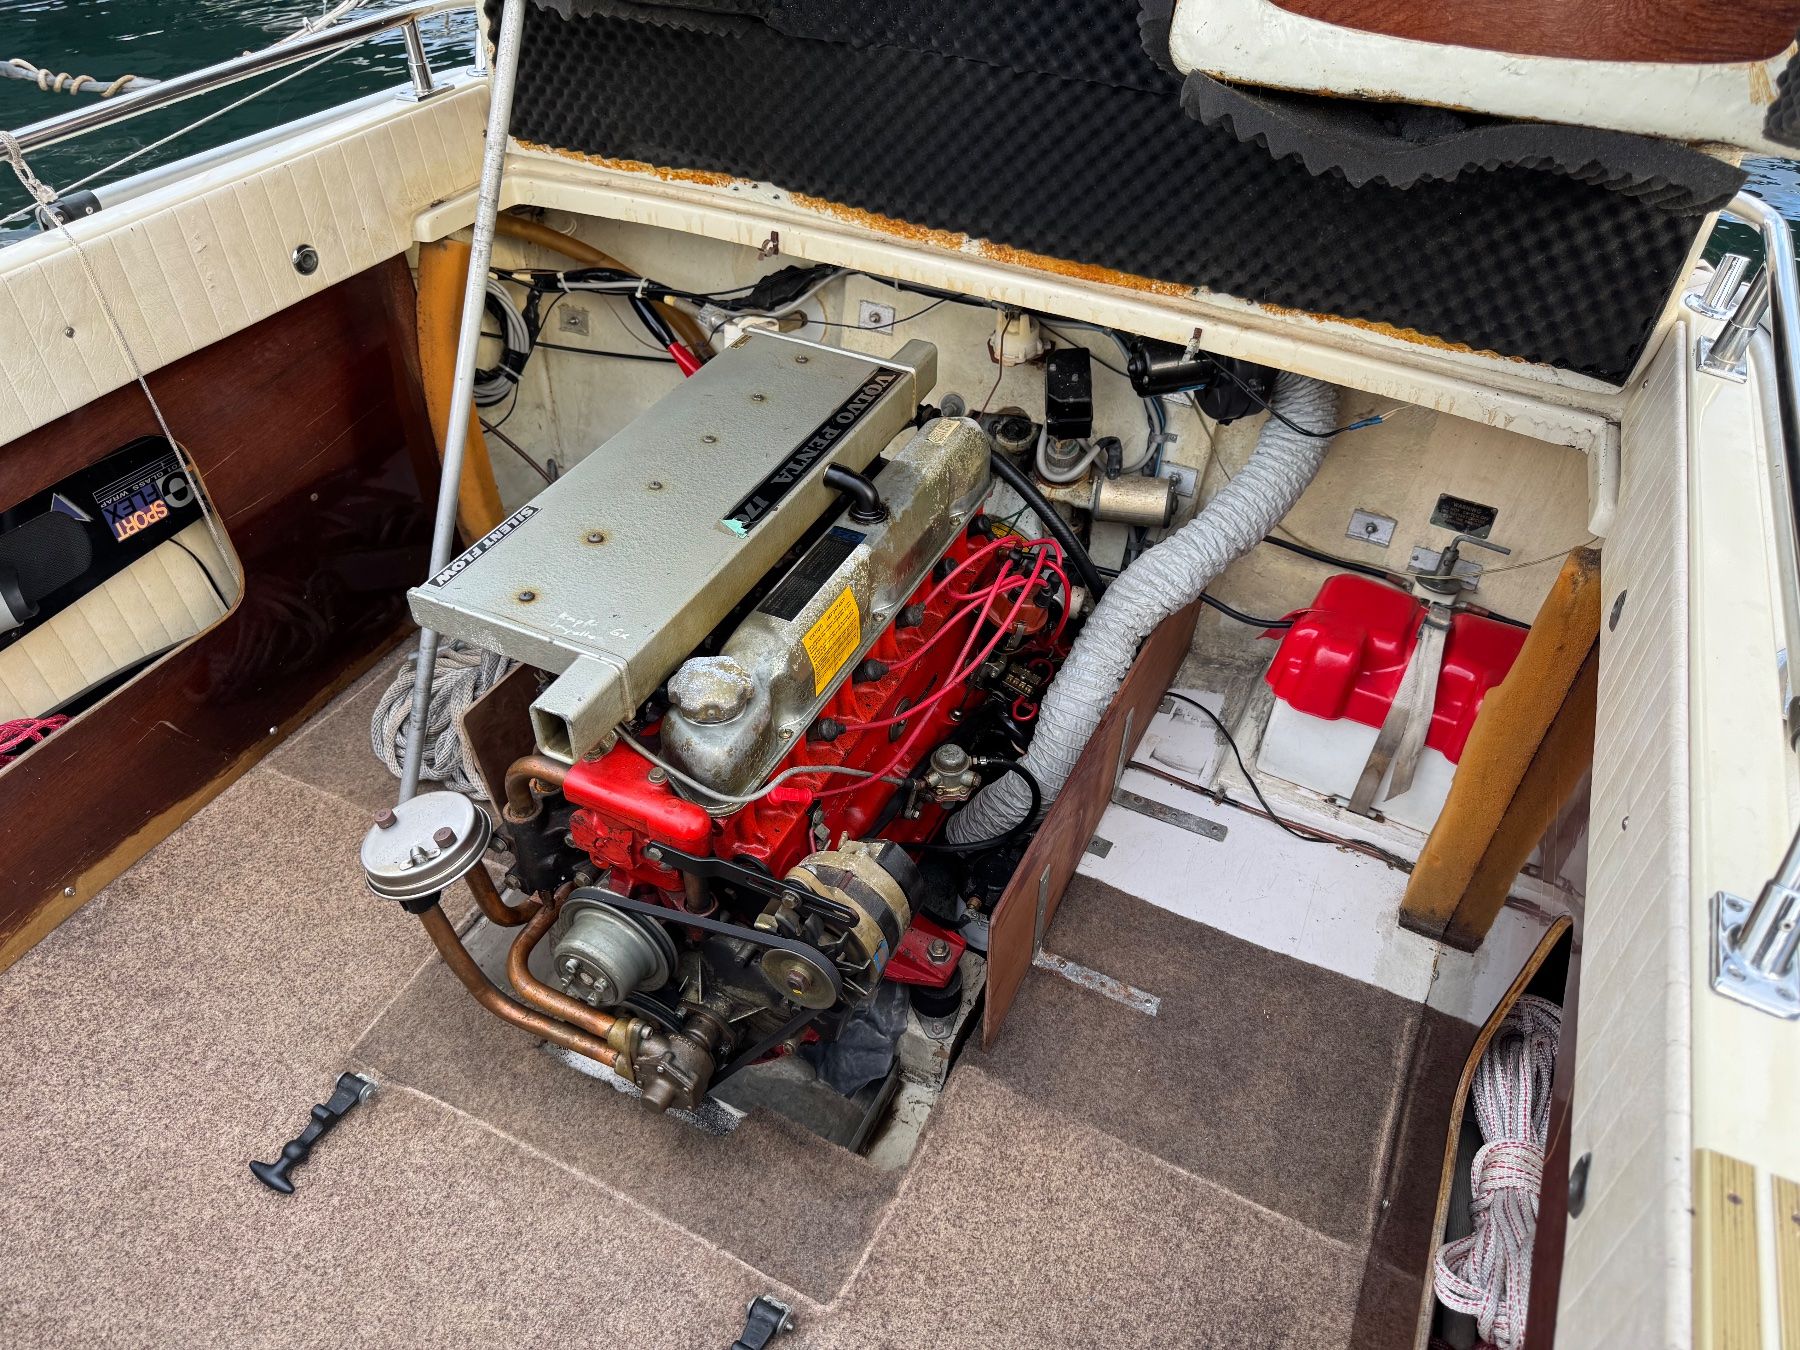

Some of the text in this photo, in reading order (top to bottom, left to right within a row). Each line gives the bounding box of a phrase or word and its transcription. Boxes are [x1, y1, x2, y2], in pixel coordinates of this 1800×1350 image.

[837, 374, 897, 424] VOLVO
[771, 426, 842, 484] PENTA
[100, 490, 130, 508] WRAP
[132, 471, 164, 491] GLASS
[103, 482, 160, 525] FLEX
[115, 500, 168, 542] SPORT
[436, 507, 534, 586] SILENT FLOW
